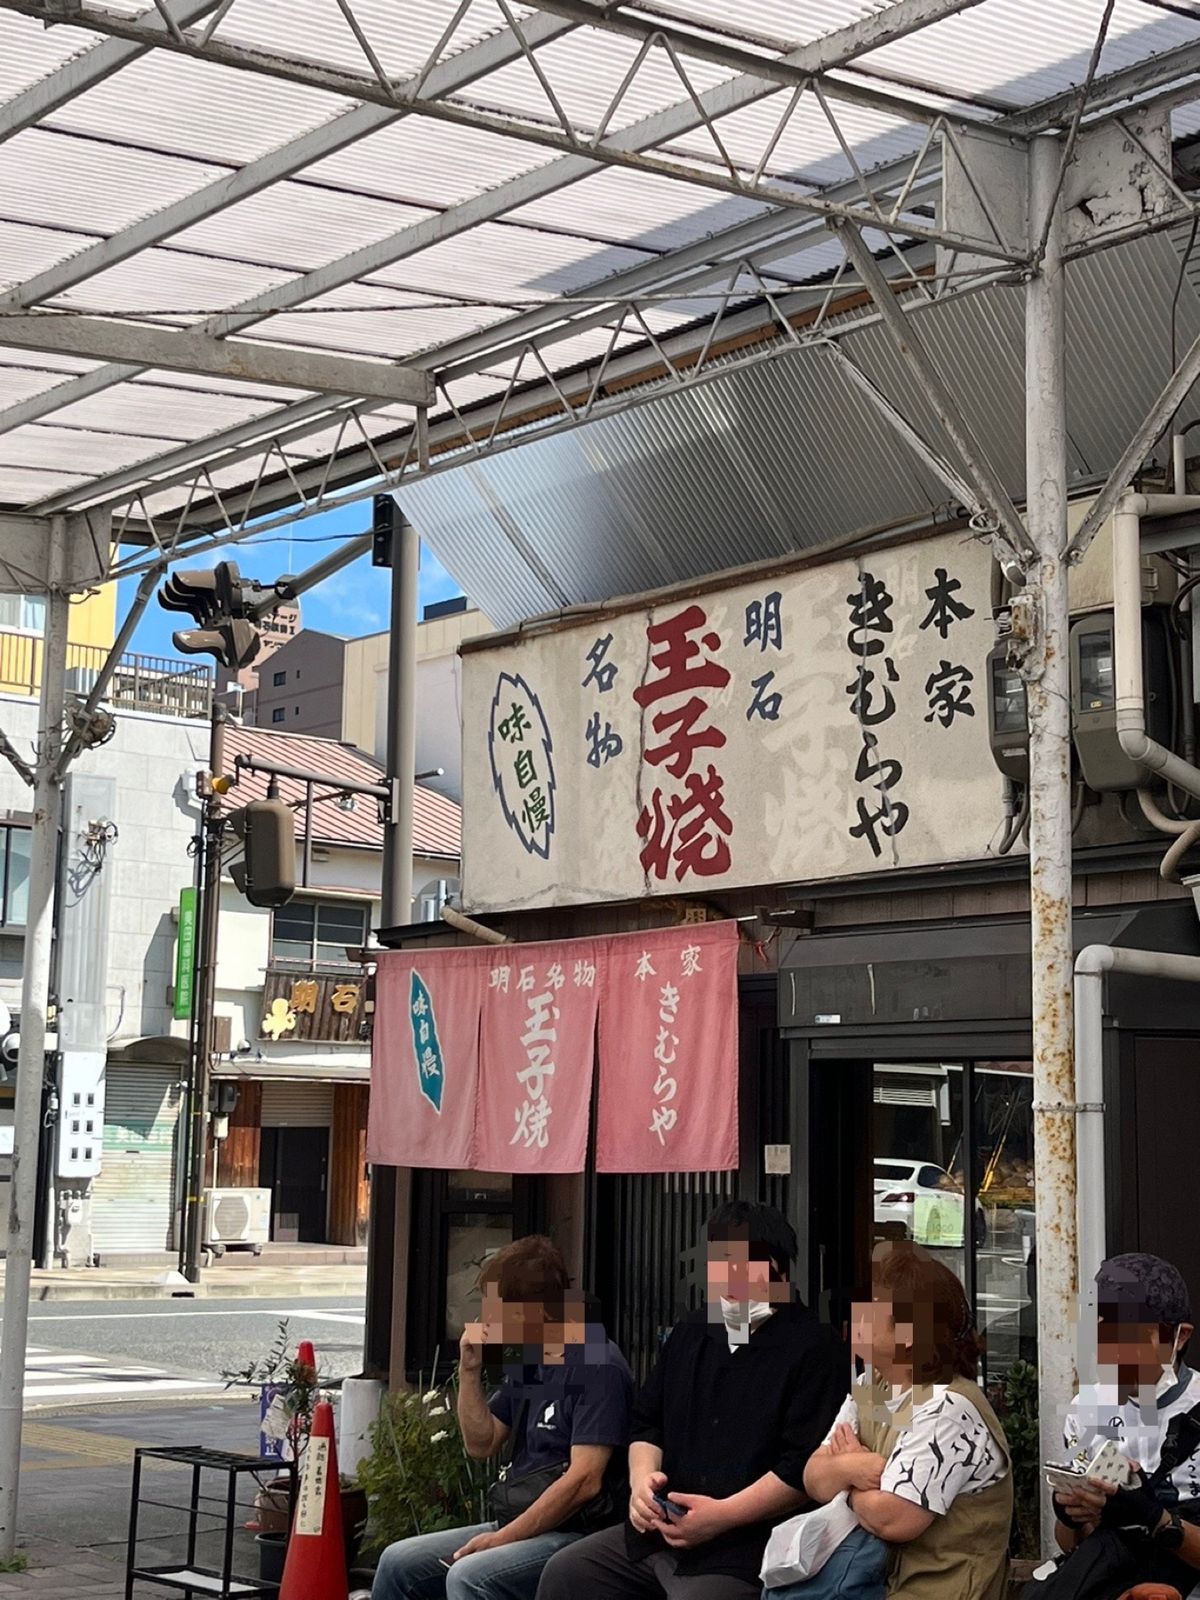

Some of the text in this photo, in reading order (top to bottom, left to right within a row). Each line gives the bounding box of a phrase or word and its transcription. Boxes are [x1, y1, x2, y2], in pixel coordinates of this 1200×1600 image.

[581, 633, 623, 769] 名物
[743, 591, 783, 722] 明石
[846, 572, 909, 857] きむらや
[919, 568, 975, 729] 本家
[498, 702, 549, 834] 味自慢
[633, 605, 733, 883] 玉子焼
[290, 979, 360, 1014] 明石
[488, 960, 597, 994] 明石名物
[634, 944, 703, 983] 本家
[509, 991, 561, 1149] 玉子焼
[648, 980, 681, 1147] きむらや
